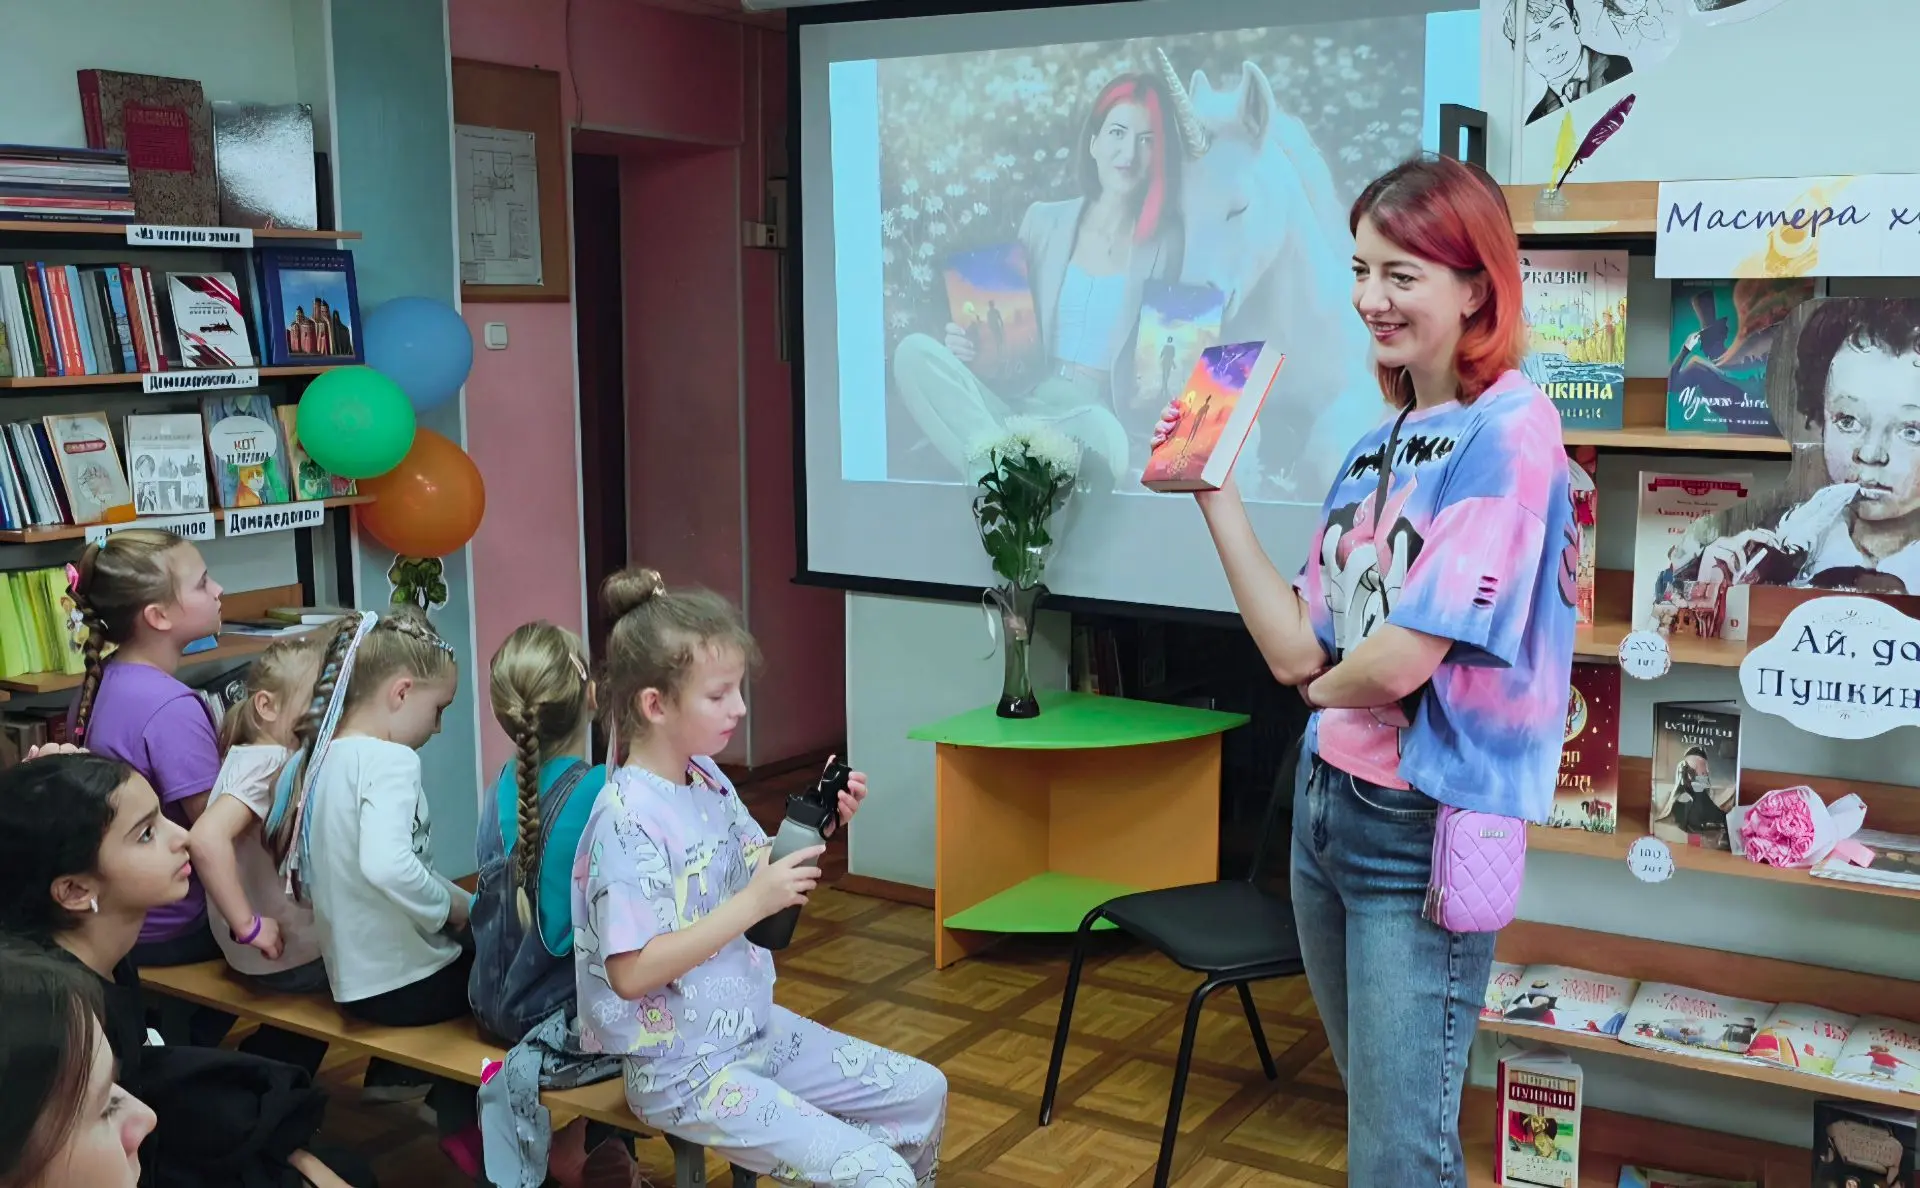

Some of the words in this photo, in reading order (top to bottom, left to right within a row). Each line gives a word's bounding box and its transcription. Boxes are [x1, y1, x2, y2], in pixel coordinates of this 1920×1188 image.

[1666, 201, 1871, 238] Мастера
[1791, 625, 1856, 659] Ай,
[1757, 667, 1920, 709] Пушкин
